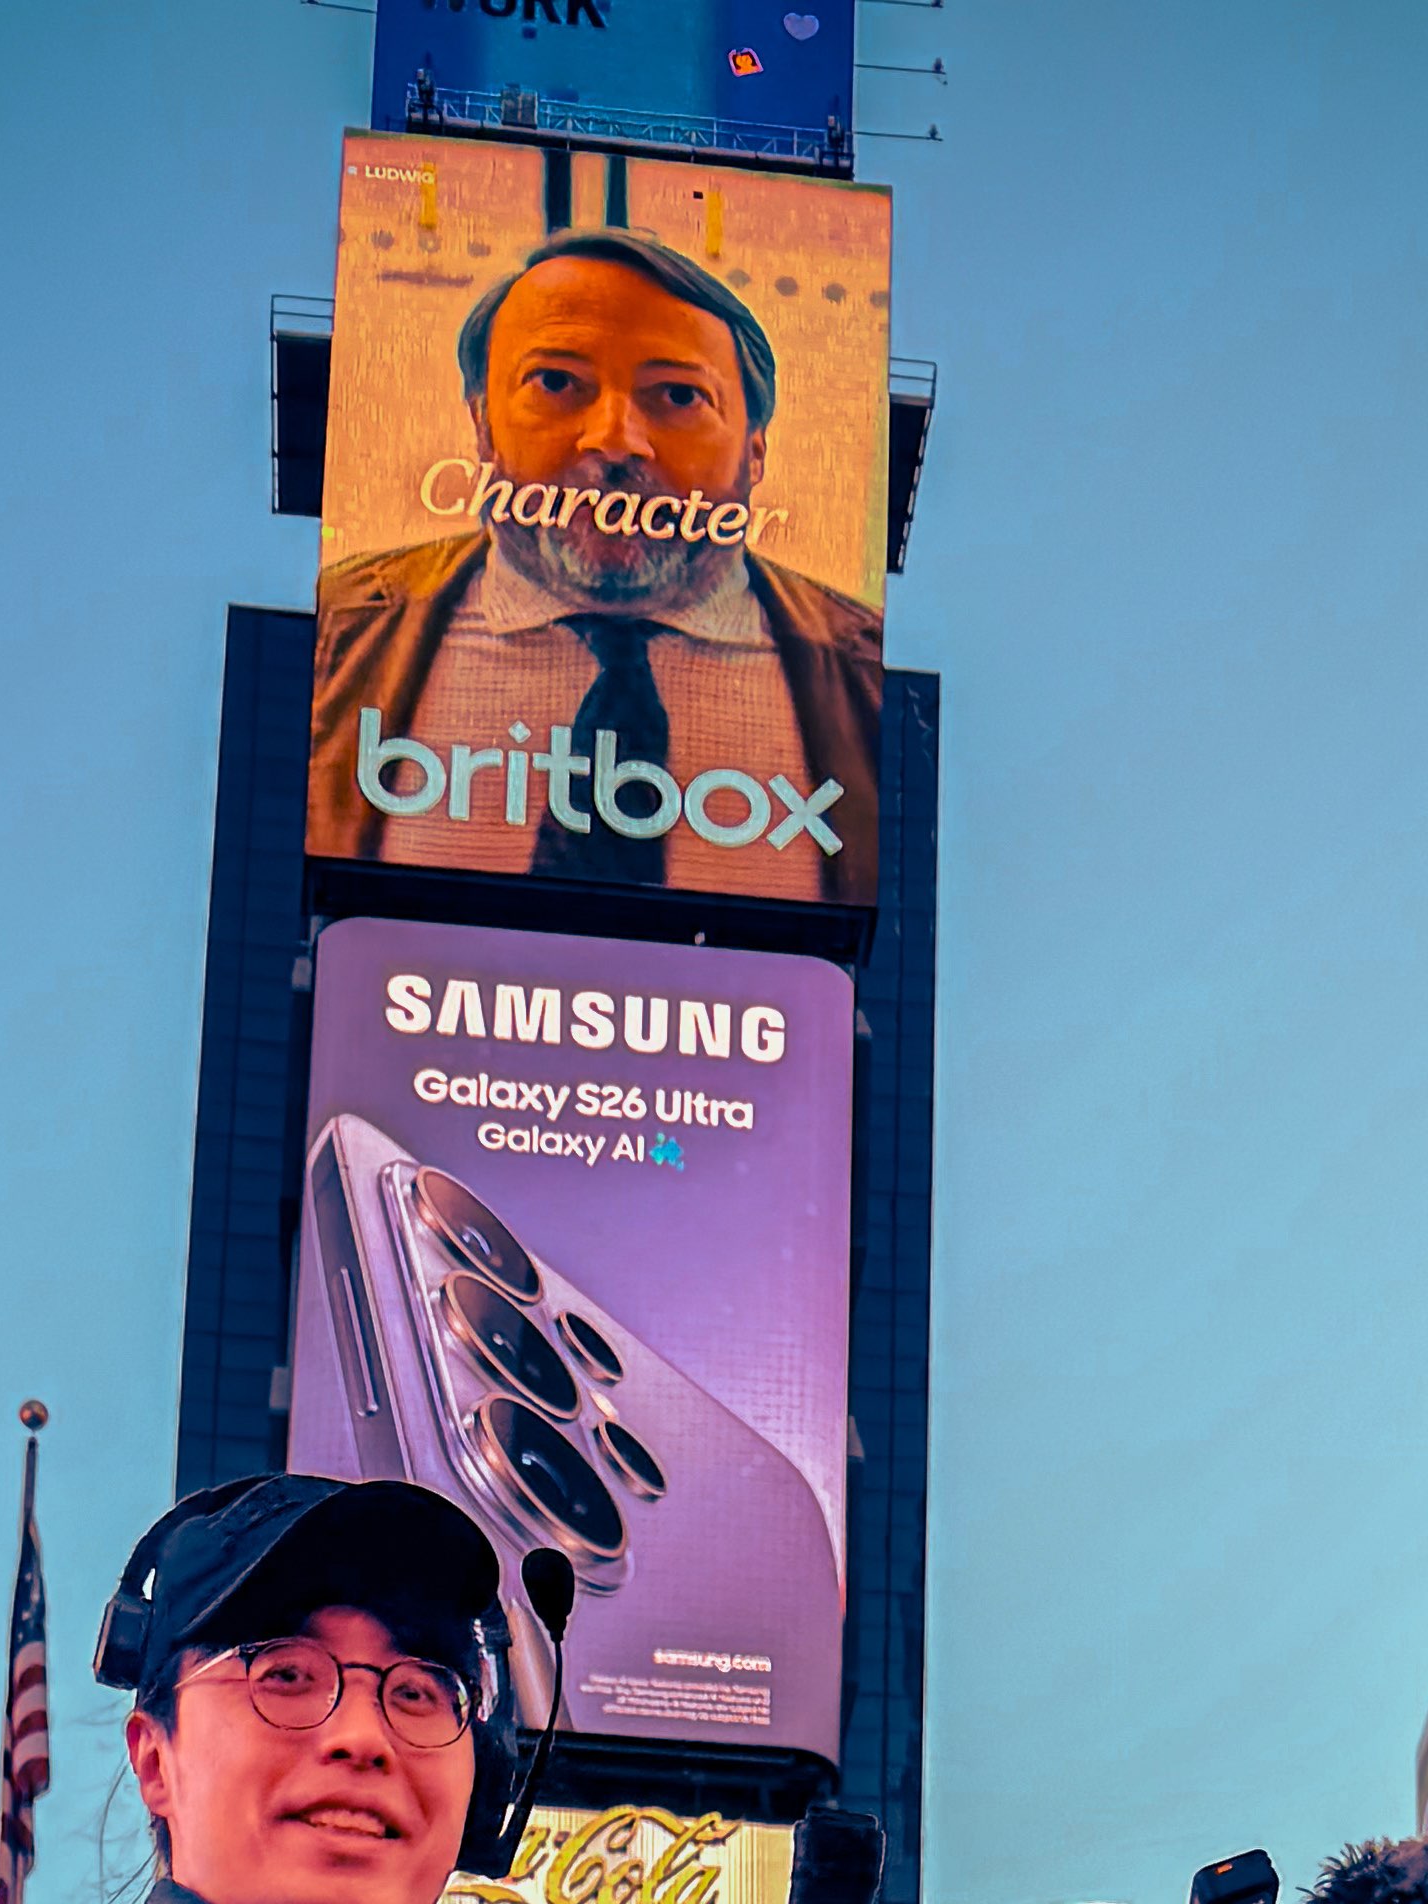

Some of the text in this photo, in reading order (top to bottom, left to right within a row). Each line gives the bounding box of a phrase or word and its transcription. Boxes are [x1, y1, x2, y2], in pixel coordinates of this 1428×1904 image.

[365, 165, 436, 185] LUDWIG
[421, 457, 789, 546] Character
[357, 706, 845, 857] britbox
[385, 974, 787, 1062] SAMSUNG
[413, 1068, 755, 1130] Galaxy S26 Ultra
[478, 1121, 645, 1165] Galaxy AI
[653, 1648, 771, 1673] samsung.com
